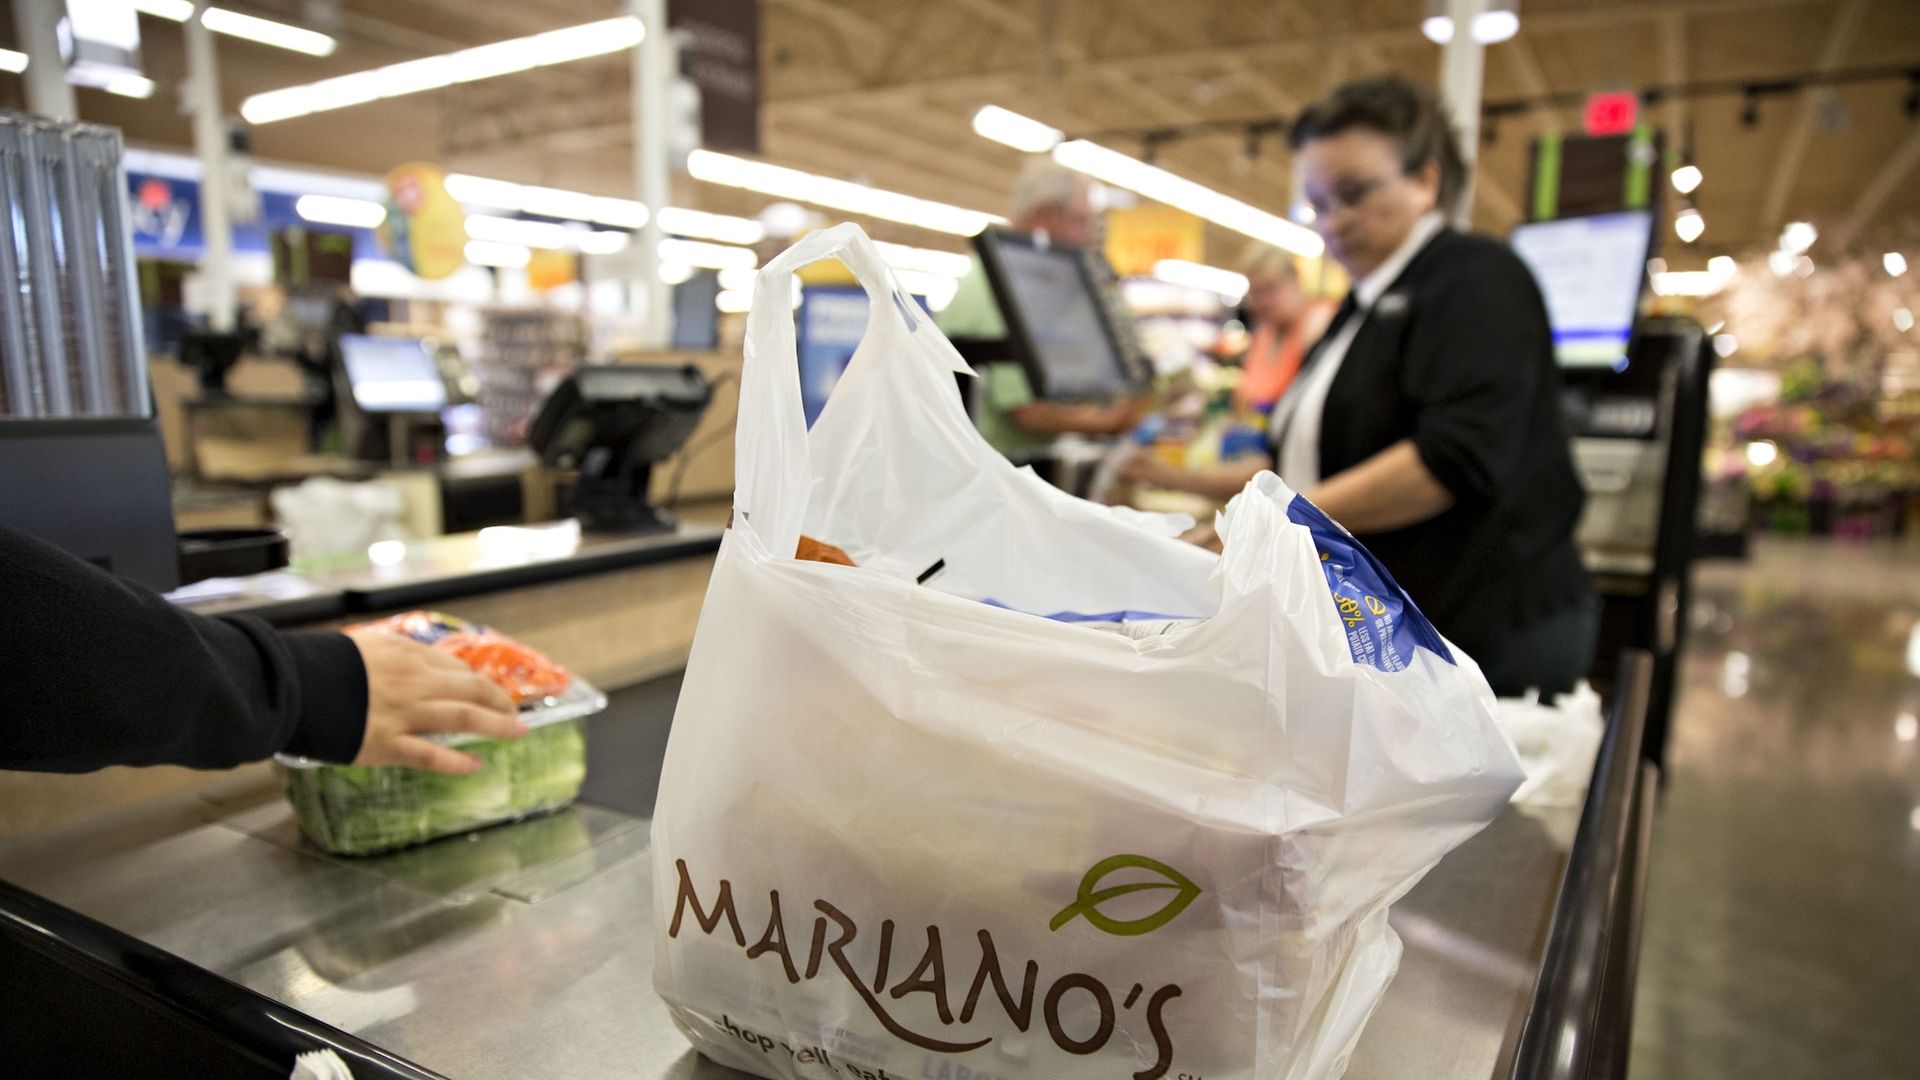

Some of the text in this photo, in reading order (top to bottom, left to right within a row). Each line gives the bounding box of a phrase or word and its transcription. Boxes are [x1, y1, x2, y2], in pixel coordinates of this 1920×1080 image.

[1375, 618, 1385, 630] OR
[1383, 614, 1393, 626] NO
[1358, 626, 1371, 643] LESS
[1348, 630, 1365, 656] POTATO
[1363, 641, 1376, 655] FAT
[668, 858, 1183, 1080] MARIANO'S
